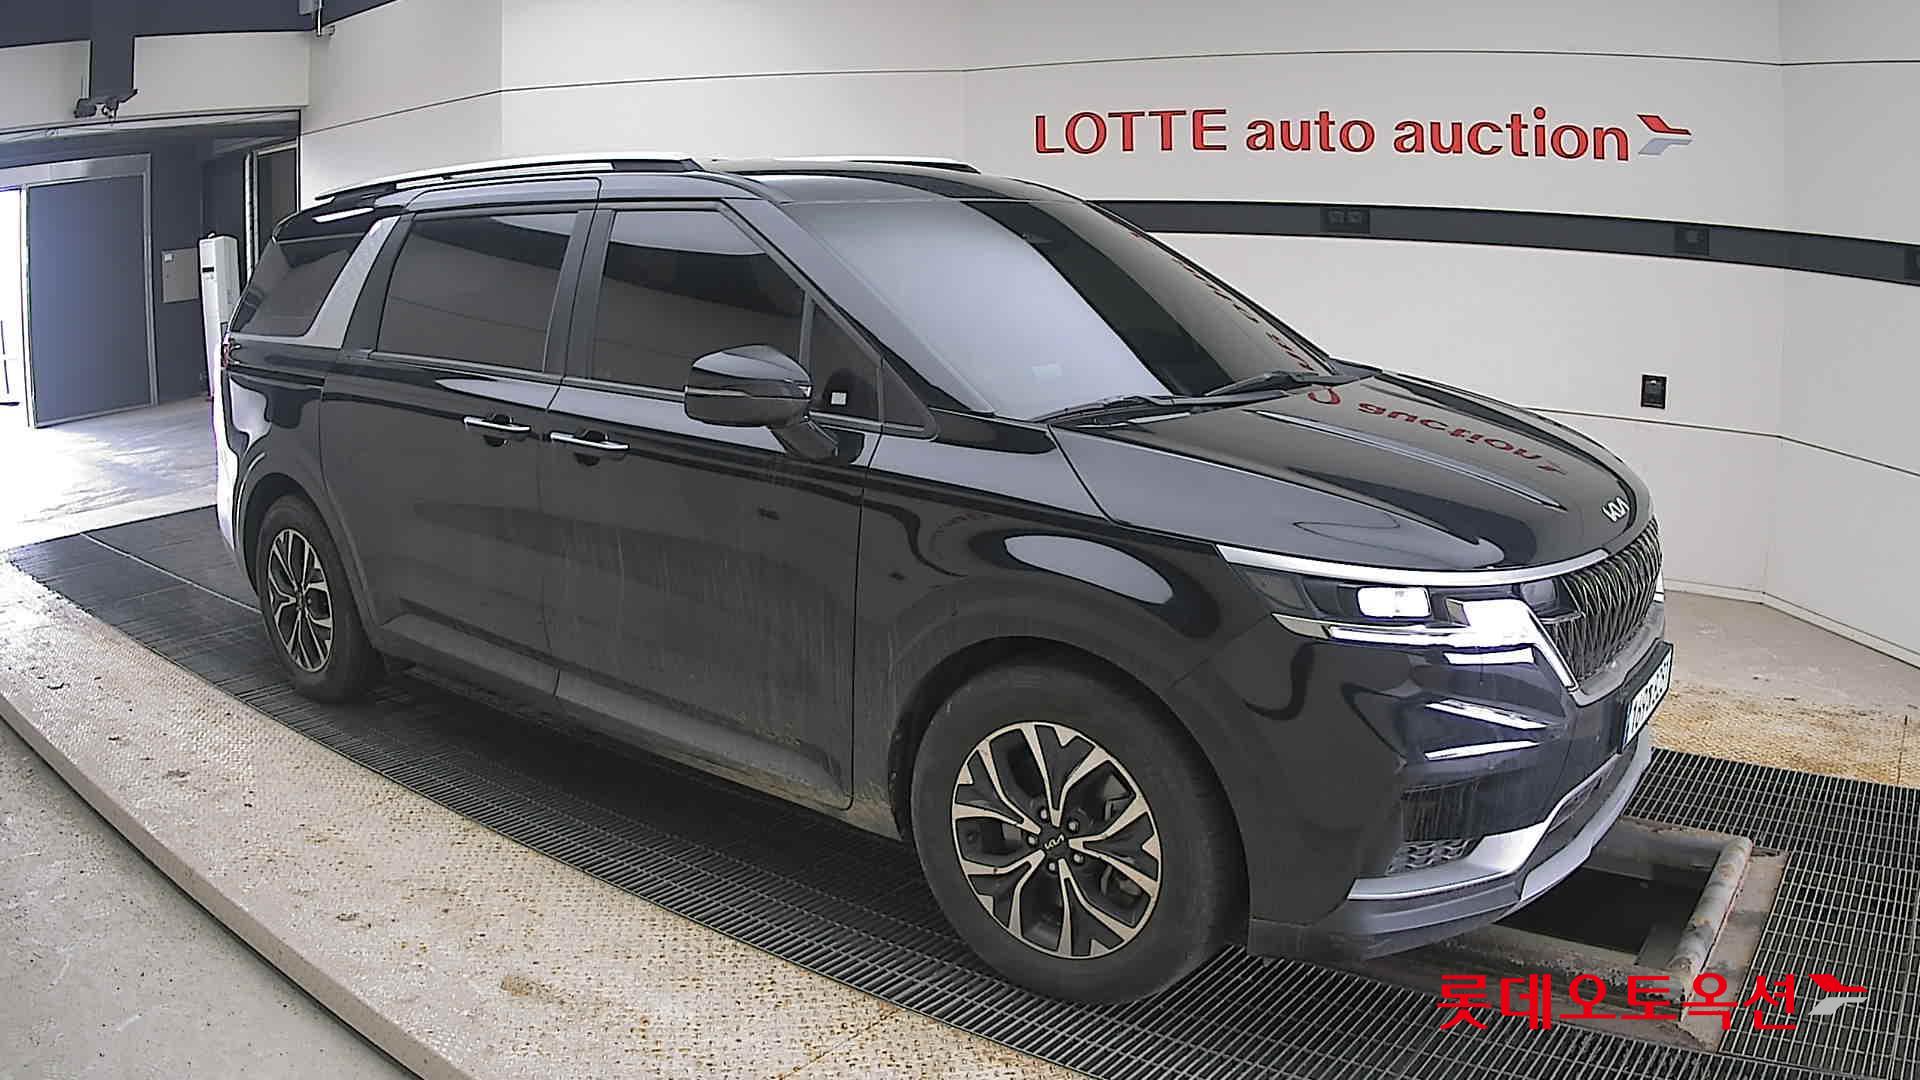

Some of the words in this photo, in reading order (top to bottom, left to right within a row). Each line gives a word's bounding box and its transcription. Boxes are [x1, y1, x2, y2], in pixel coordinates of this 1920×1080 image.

[1034, 109, 1227, 154] LOTTE
[1246, 110, 1376, 153] auto
[1392, 106, 1630, 162] auction
